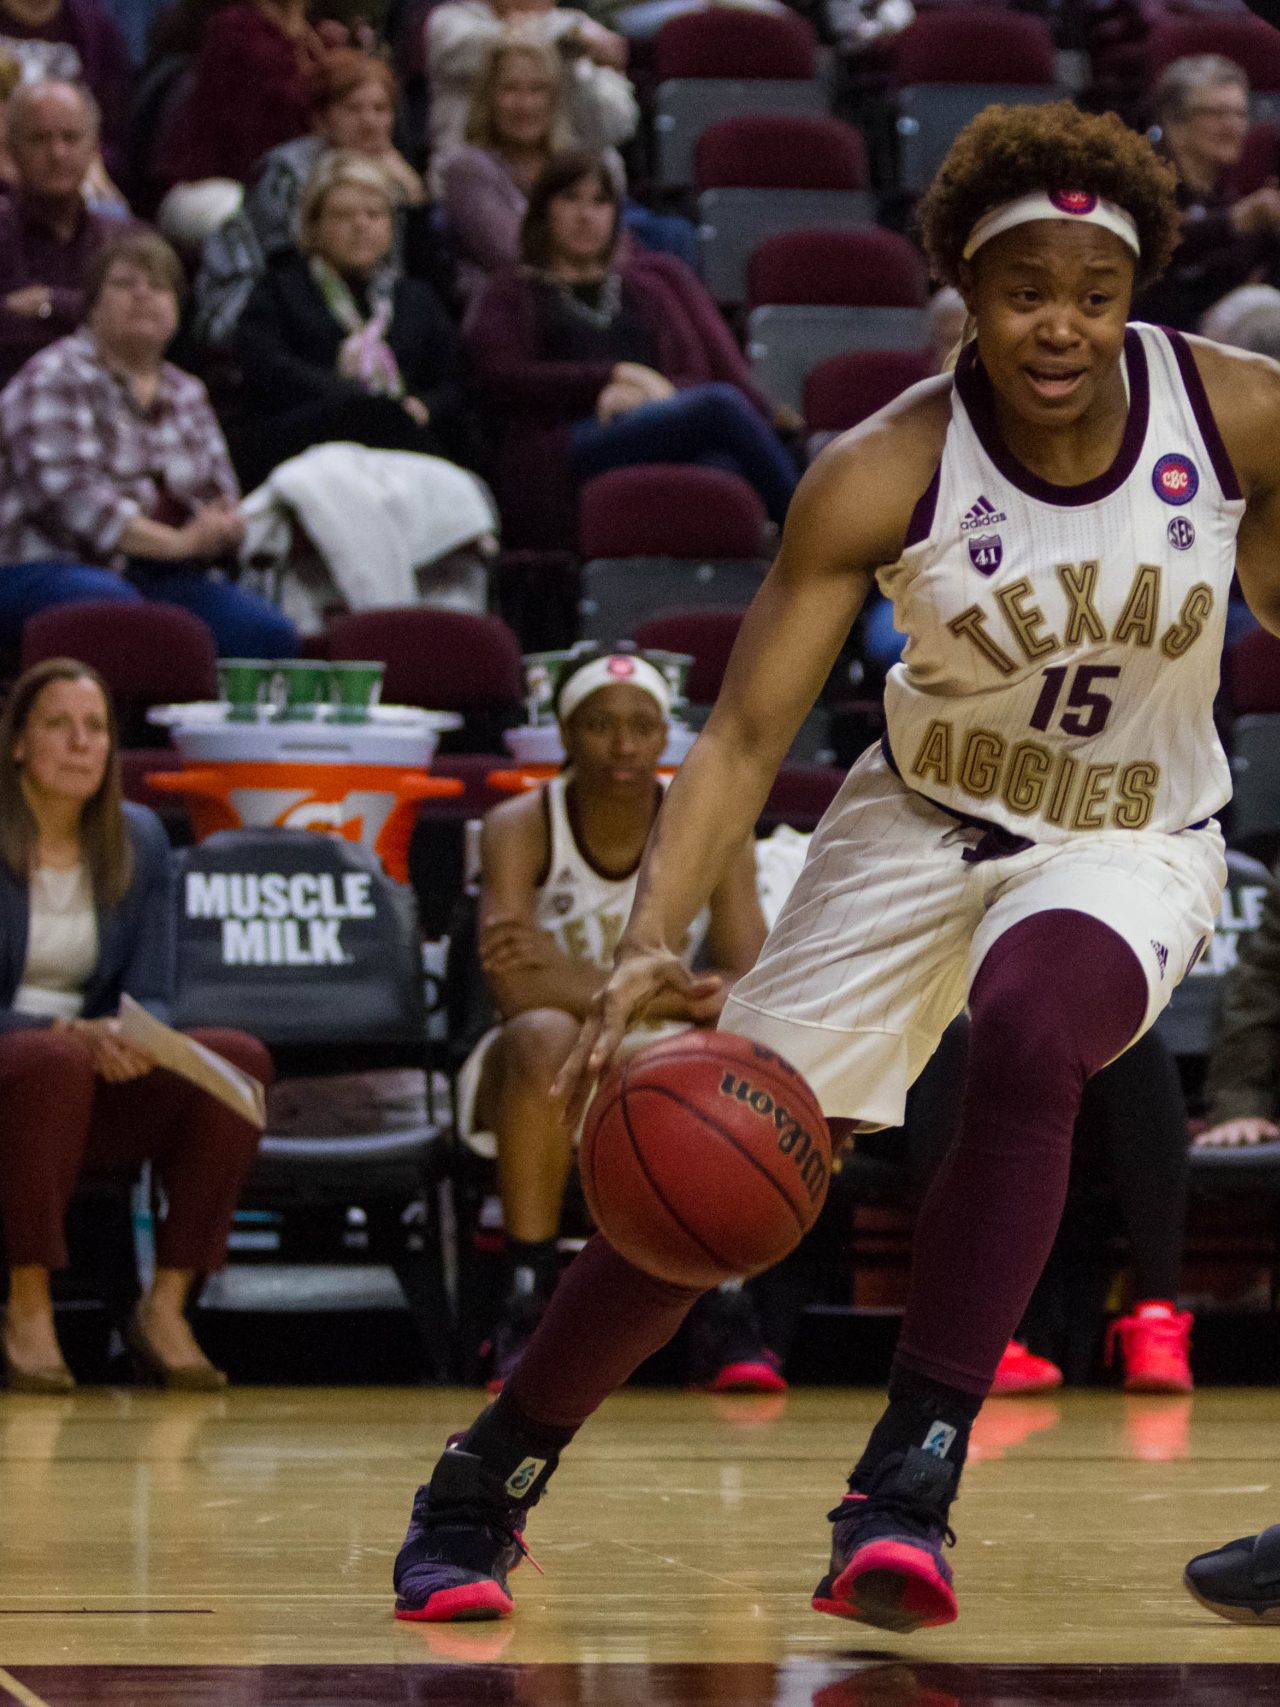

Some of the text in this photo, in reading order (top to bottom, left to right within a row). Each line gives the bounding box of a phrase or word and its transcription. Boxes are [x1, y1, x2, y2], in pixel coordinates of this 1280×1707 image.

[1162, 469, 1188, 489] CBC
[960, 512, 1007, 530] adidas
[1168, 518, 1194, 547] SEC
[974, 547, 998, 566] 41
[947, 560, 1214, 677] TEXAS
[1028, 664, 1122, 738] 15
[910, 719, 1161, 832] AGGIES
[185, 872, 376, 919] MUSCLE
[222, 918, 346, 966] MILK
[721, 1072, 826, 1204] Wilson
